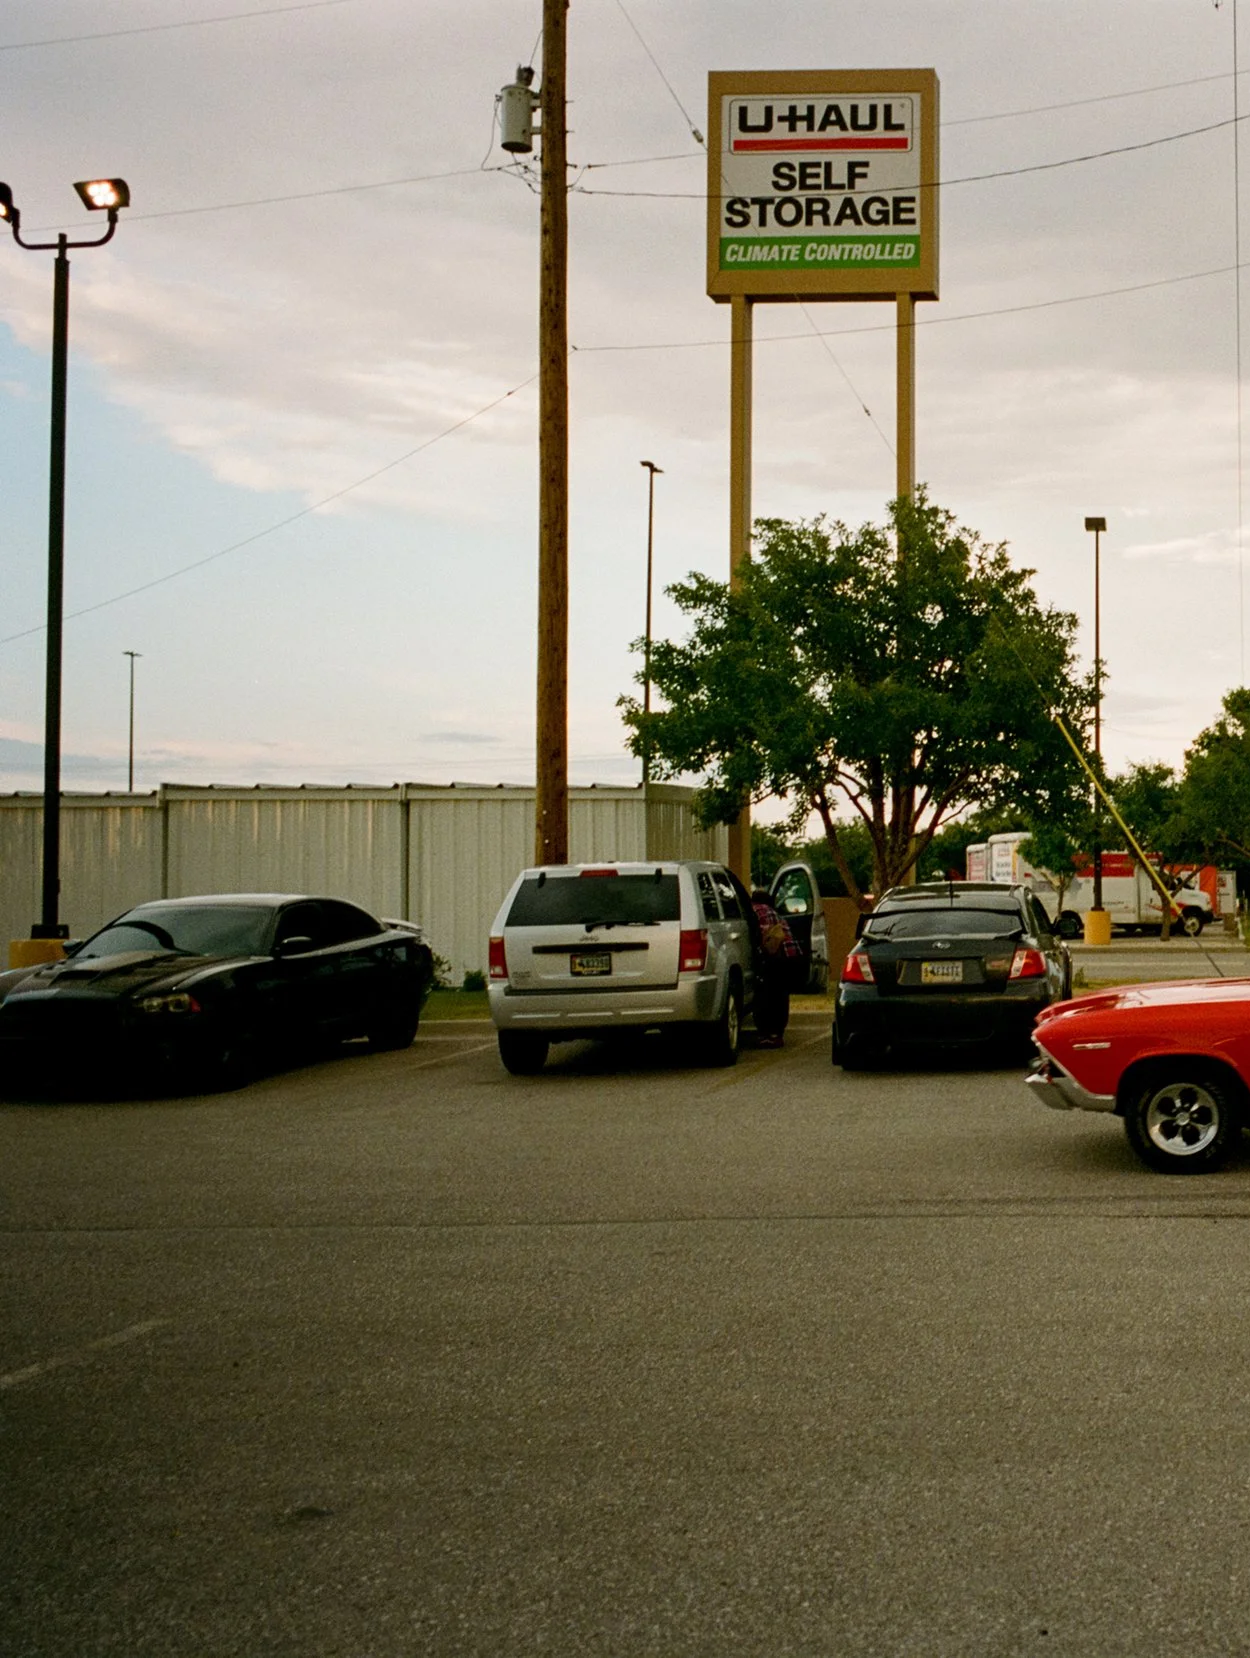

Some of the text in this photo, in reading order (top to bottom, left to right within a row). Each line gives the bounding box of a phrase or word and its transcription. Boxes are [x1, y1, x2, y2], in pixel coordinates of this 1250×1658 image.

[738, 103, 905, 133] U-HAUL
[771, 161, 870, 191] SELF
[724, 196, 916, 228] STORAGE
[725, 242, 915, 262] CLIMATE CONTROLLED
